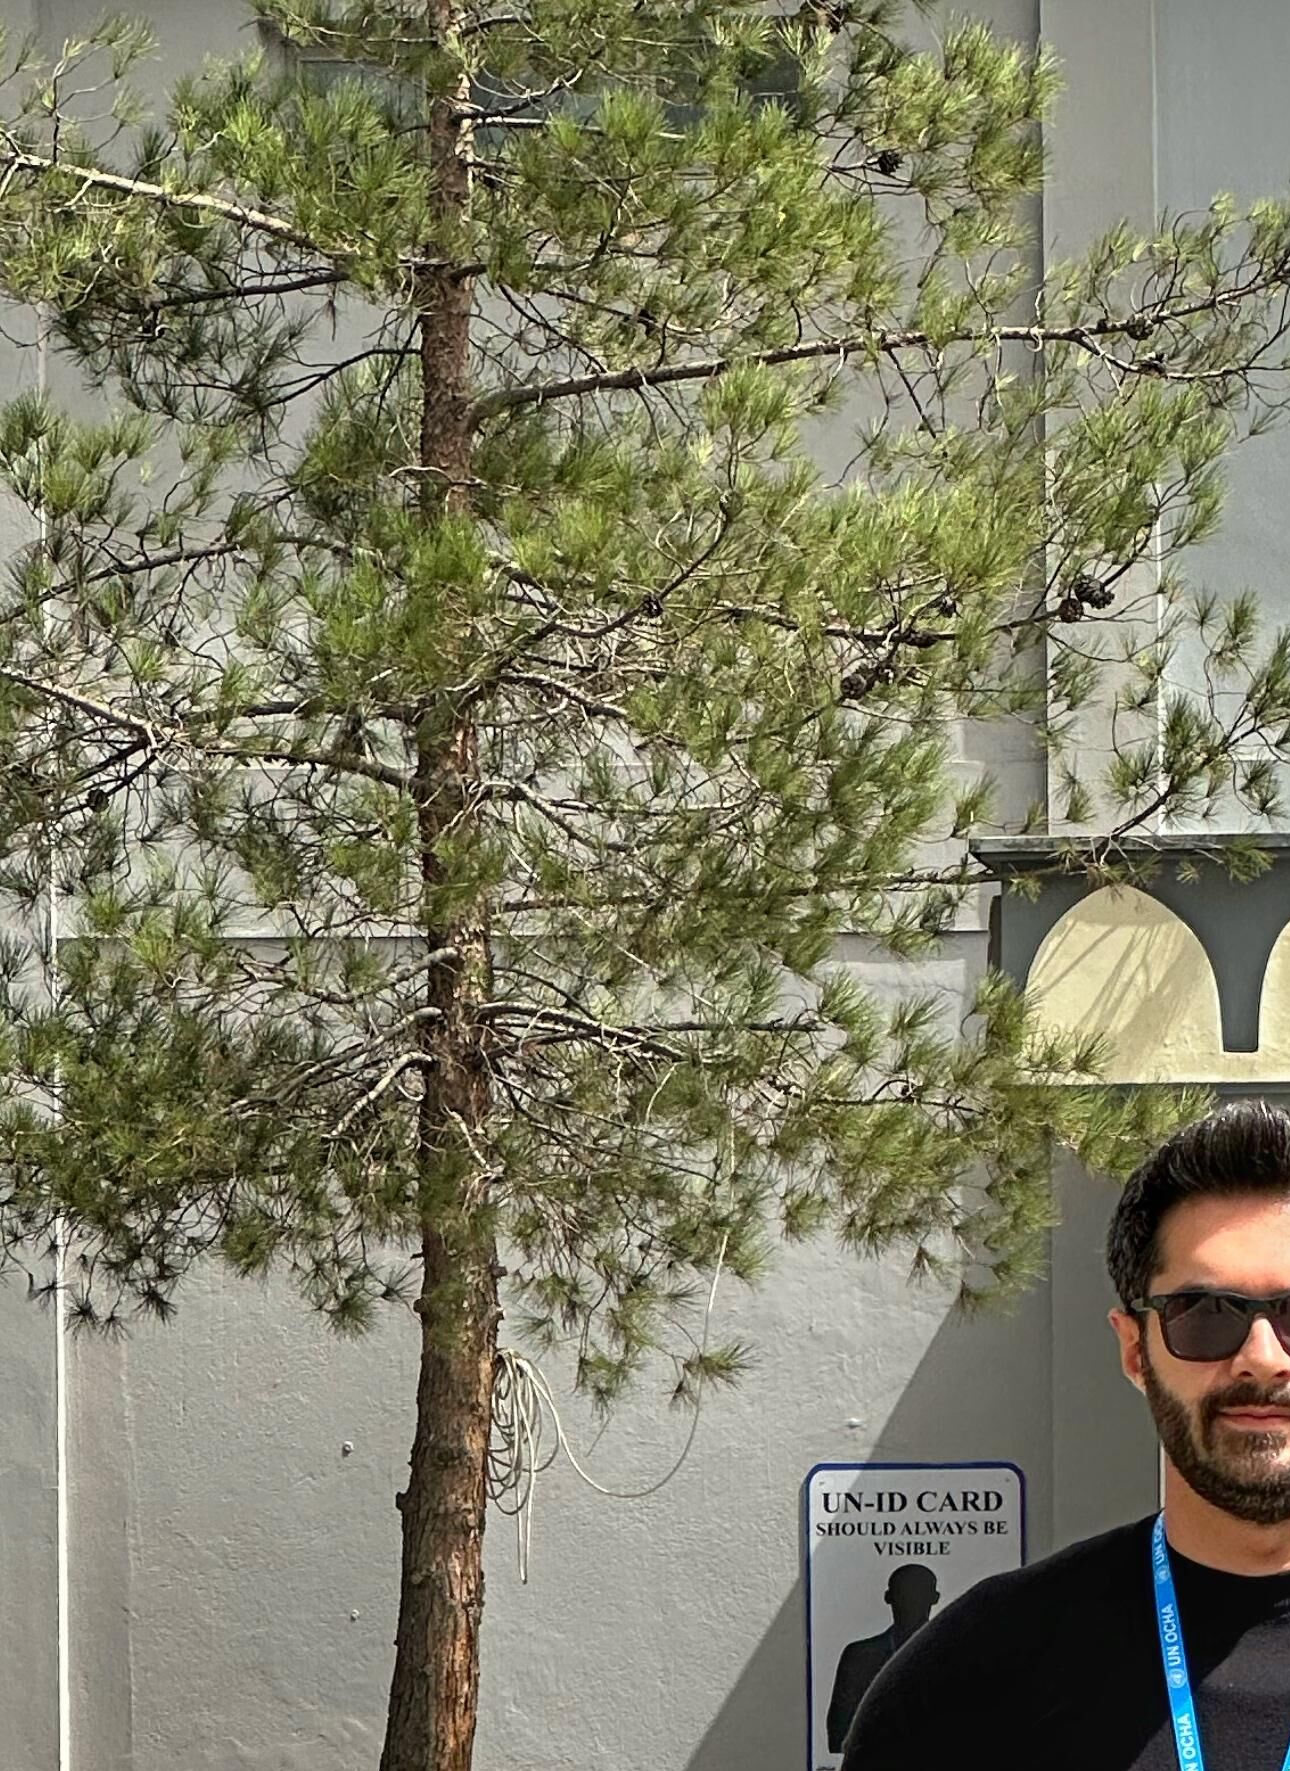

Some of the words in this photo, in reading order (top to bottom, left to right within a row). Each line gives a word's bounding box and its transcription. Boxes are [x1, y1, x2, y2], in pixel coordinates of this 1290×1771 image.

[822, 1491, 908, 1514] UN-ID
[916, 1490, 1004, 1513] CARD
[816, 1522, 896, 1536] SHOULD
[900, 1521, 978, 1536] ALWAYS
[984, 1520, 1009, 1535] BE
[874, 1541, 951, 1556] VISIBLE
[1161, 1603, 1178, 1645] OCHA
[1167, 1645, 1181, 1666] UN
[1176, 1713, 1196, 1759] OCHA
